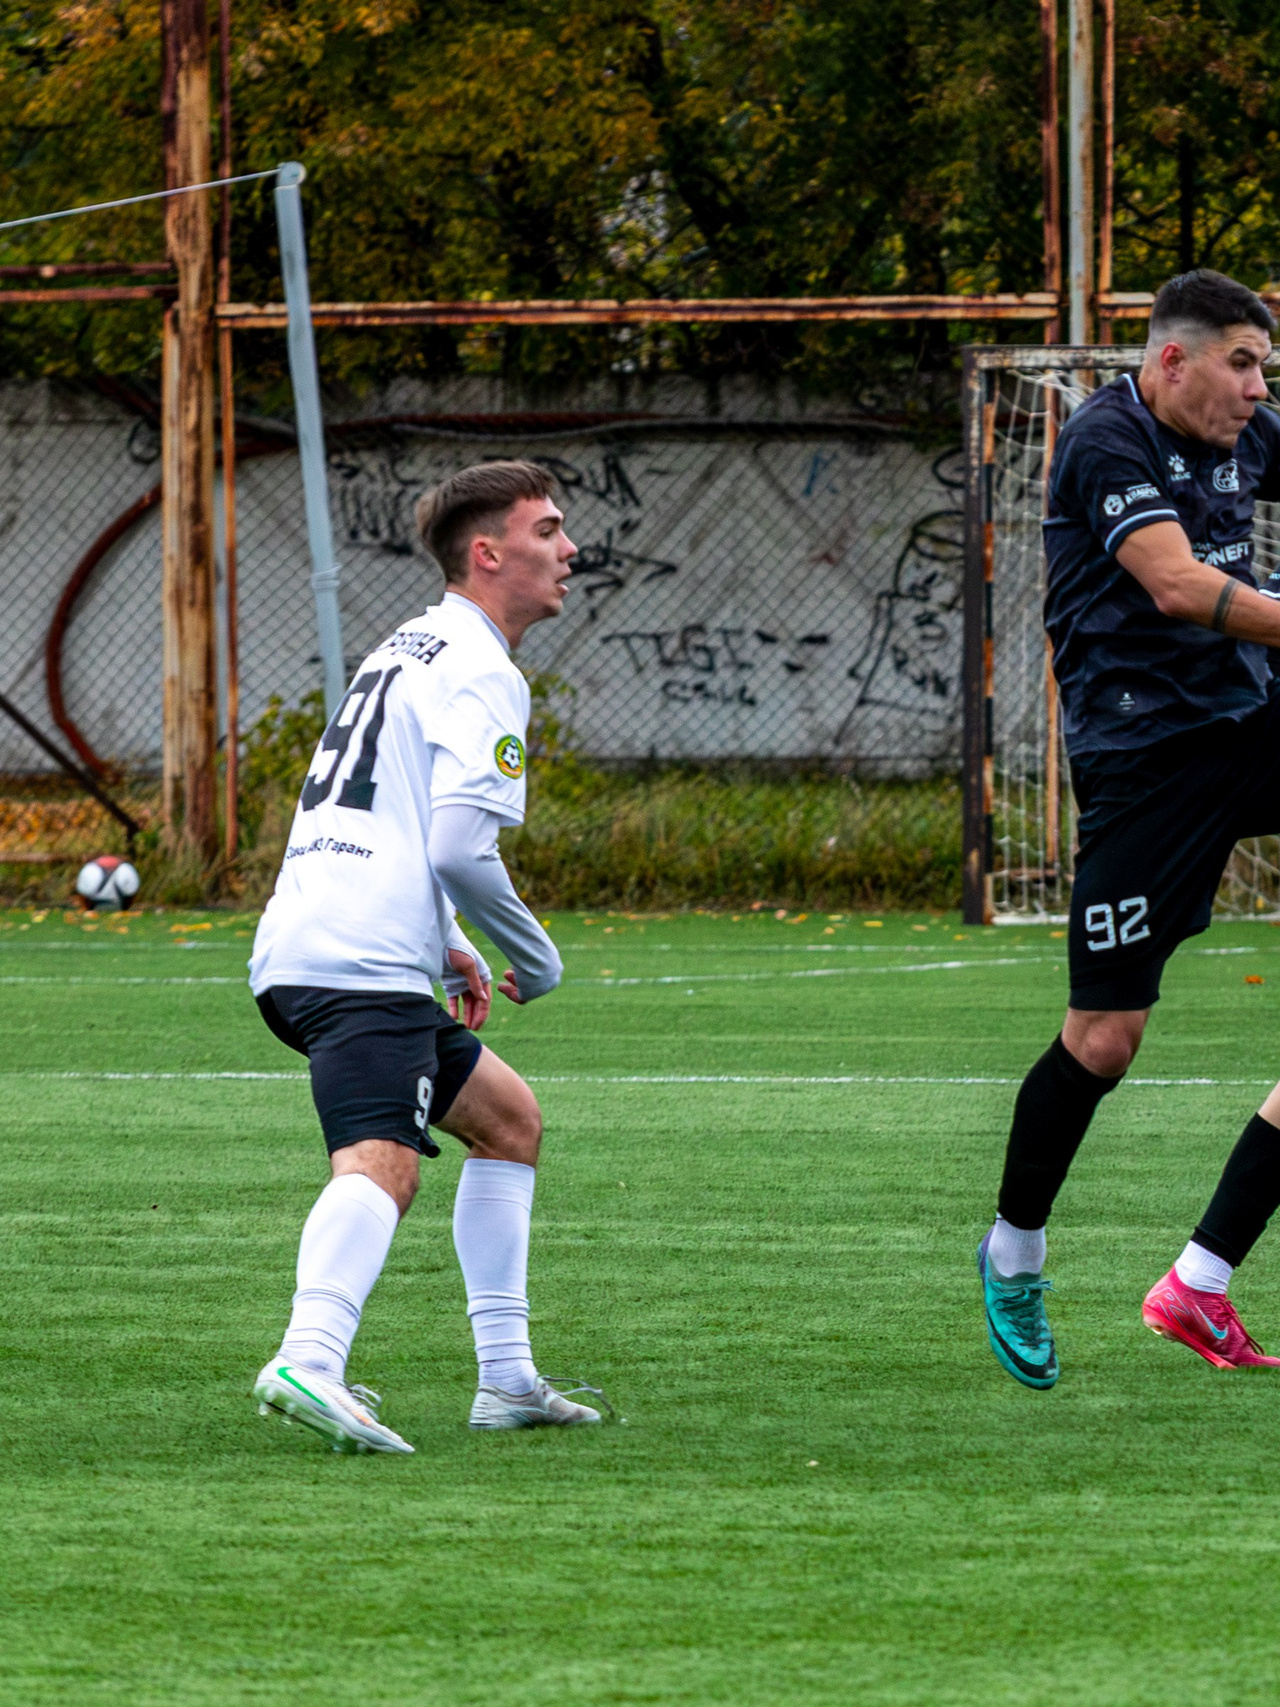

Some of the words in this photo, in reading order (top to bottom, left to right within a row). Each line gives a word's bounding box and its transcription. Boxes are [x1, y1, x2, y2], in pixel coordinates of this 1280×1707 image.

[300, 665, 403, 812] 91
[324, 837, 374, 859] Гарант
[1085, 895, 1151, 951] 92
